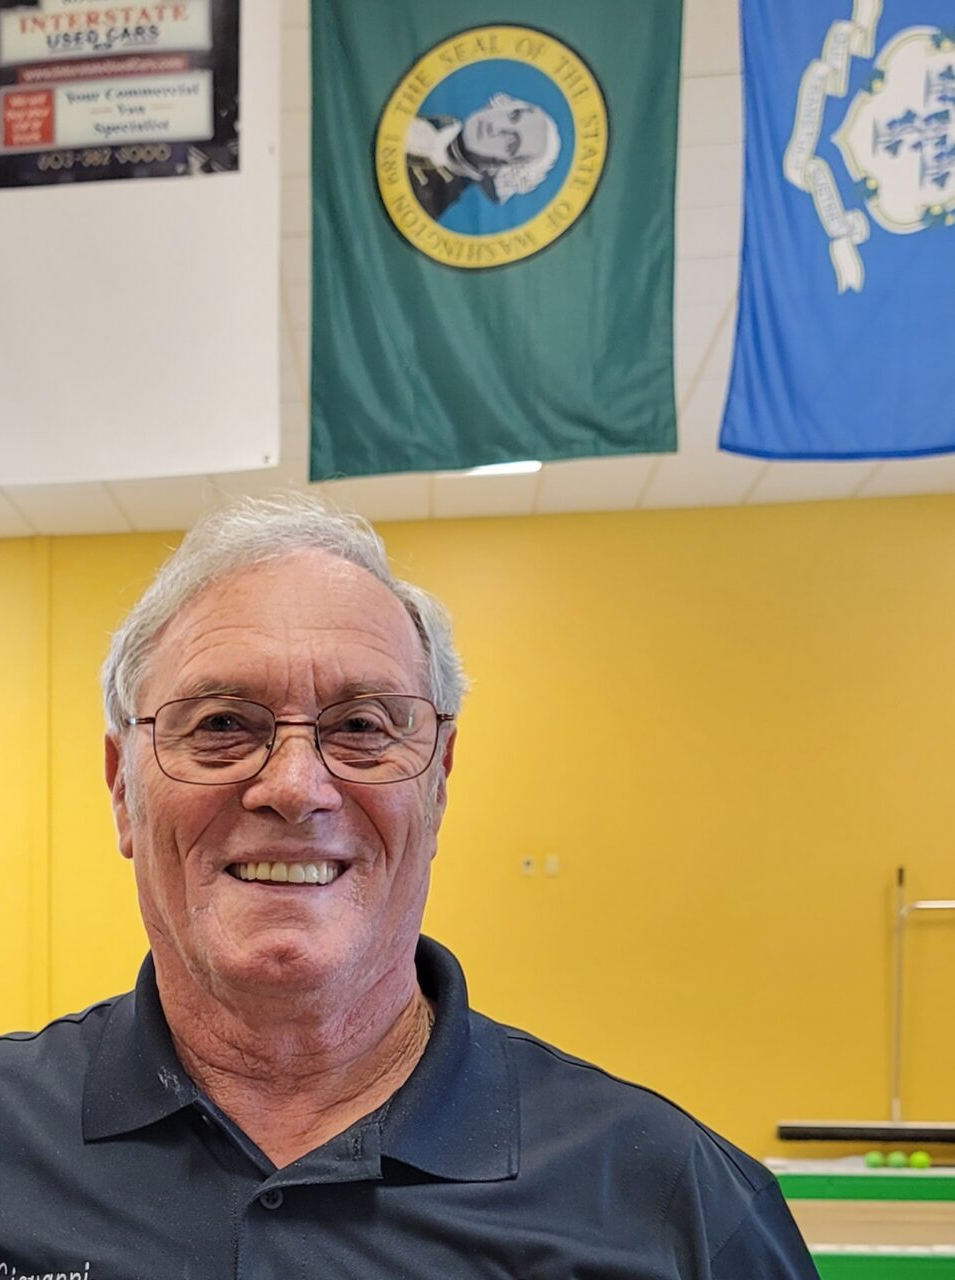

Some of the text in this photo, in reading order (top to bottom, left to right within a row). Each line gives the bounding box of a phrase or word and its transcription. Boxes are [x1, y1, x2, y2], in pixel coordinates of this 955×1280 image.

[19, 4, 189, 34] INTERSTATE
[47, 24, 159, 49] USED CARS
[396, 34, 600, 261] THE SEAL OF THE STATE OF WASHINGTON
